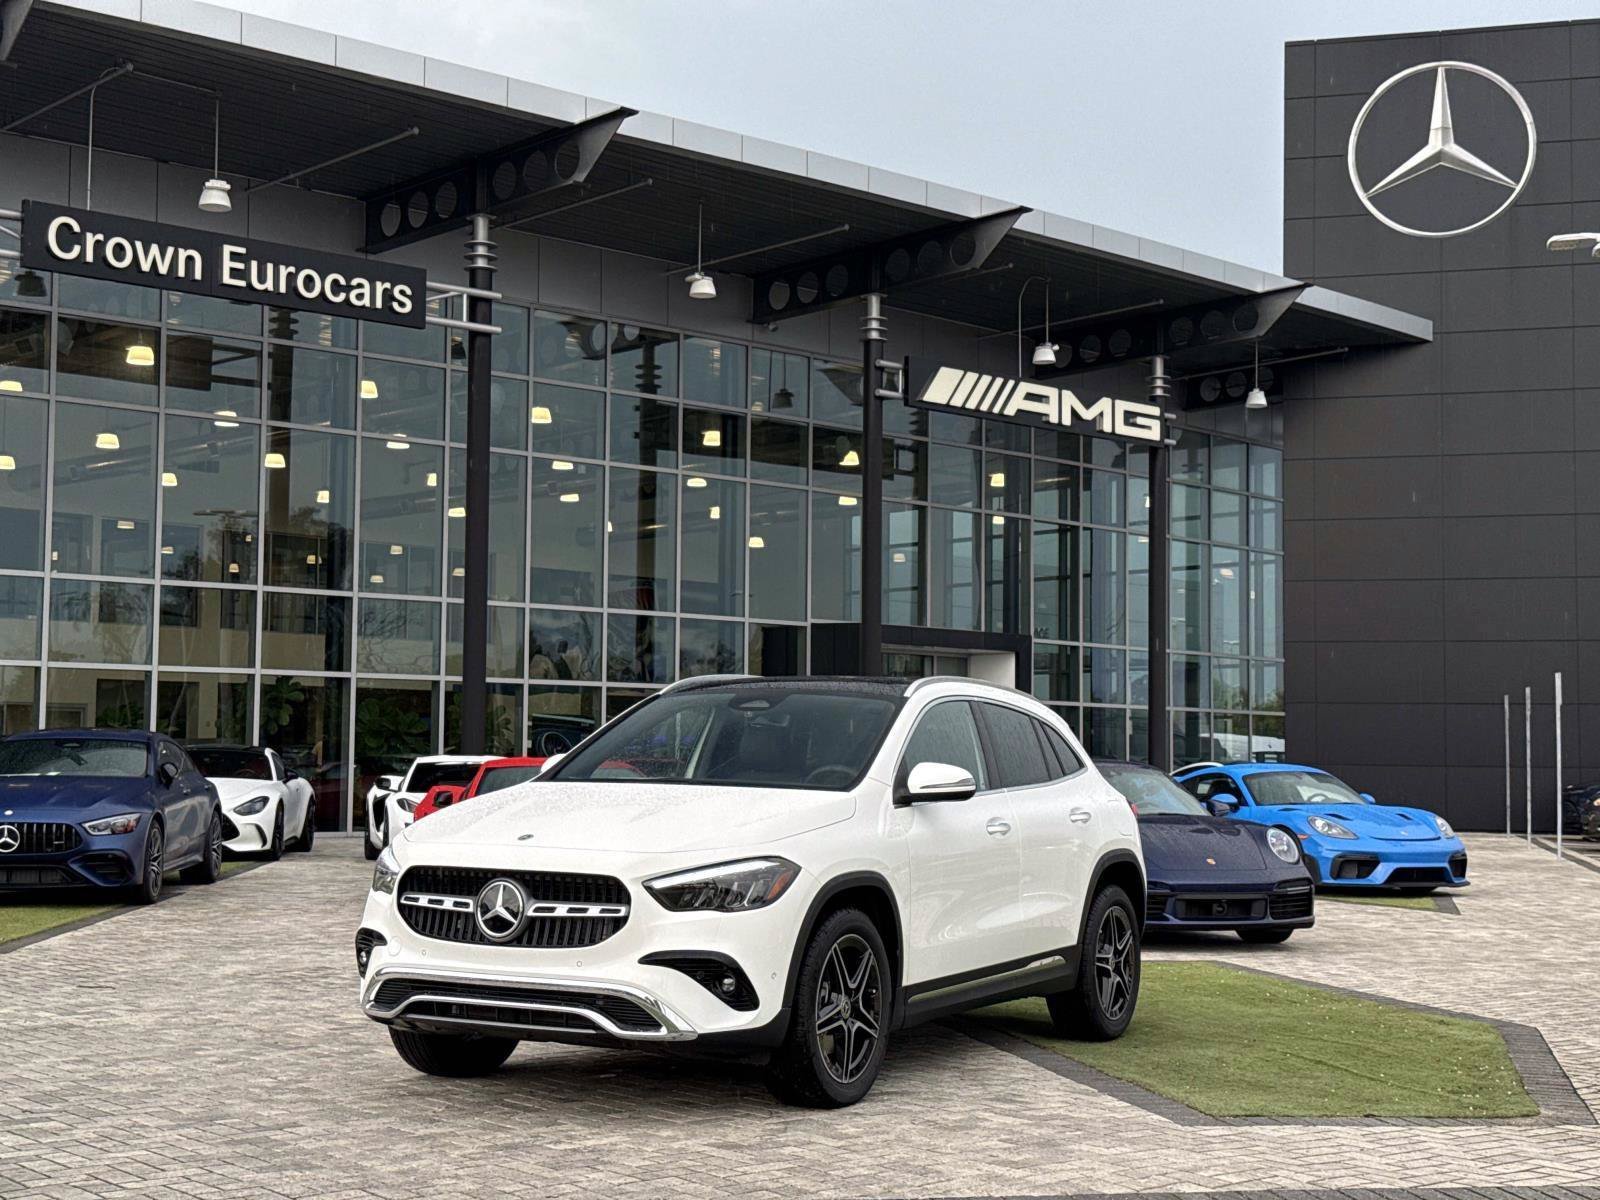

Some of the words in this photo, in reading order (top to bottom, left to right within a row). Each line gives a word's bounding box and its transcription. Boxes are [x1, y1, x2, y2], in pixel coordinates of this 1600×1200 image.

[47, 216, 202, 280] Crown
[221, 244, 413, 314] Eurocars
[1003, 381, 1161, 441] AMG
